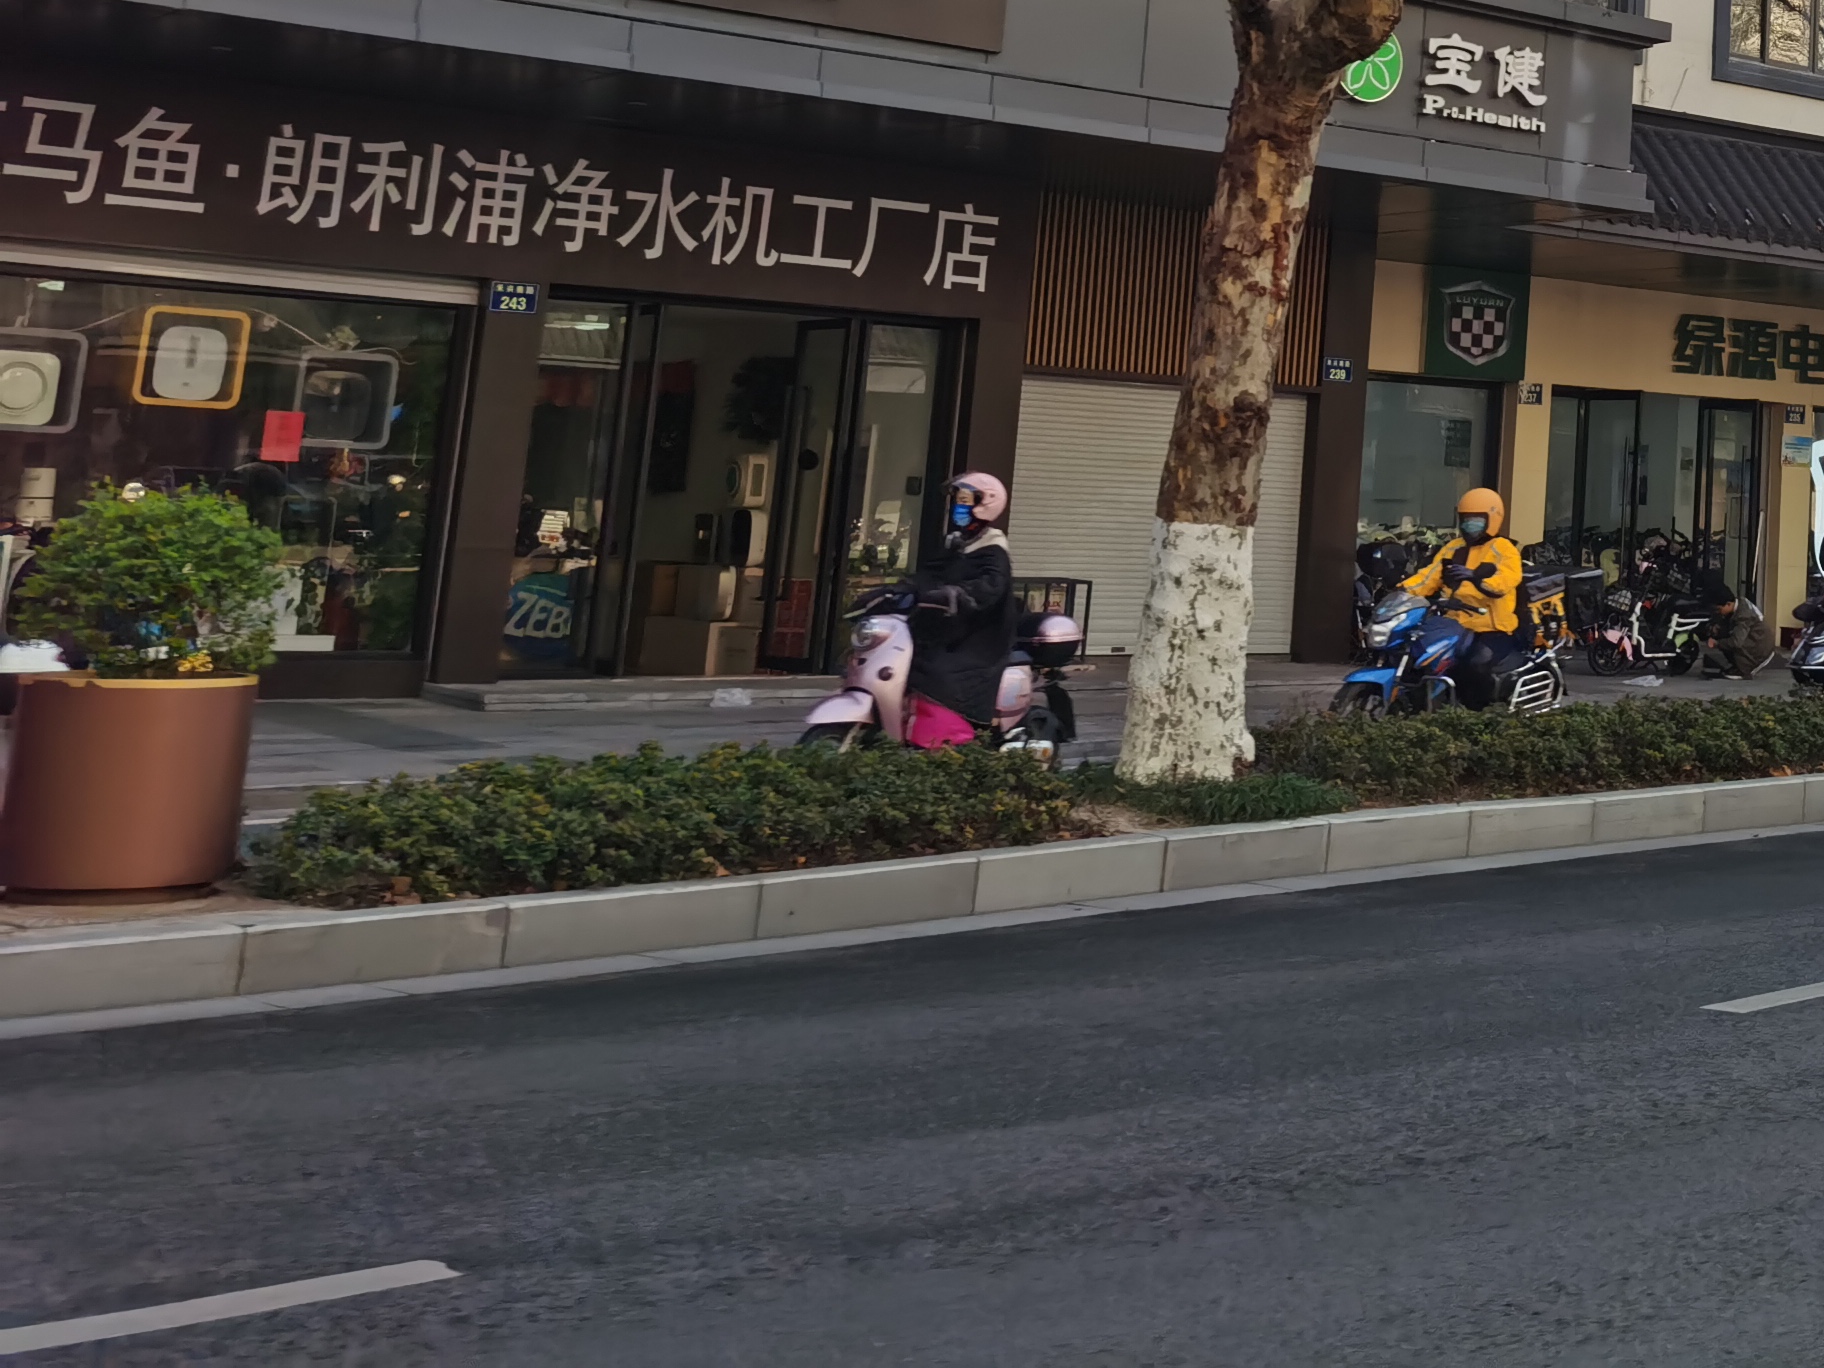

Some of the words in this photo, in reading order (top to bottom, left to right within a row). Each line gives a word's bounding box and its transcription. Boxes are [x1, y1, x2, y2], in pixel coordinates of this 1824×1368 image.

[1424, 33, 1548, 107] 宝健
[0, 96, 999, 292] 马鱼·朗利浦净水机工厂店
[500, 296, 527, 311] 243
[1329, 368, 1347, 380] 239
[503, 591, 571, 639] ZEB
